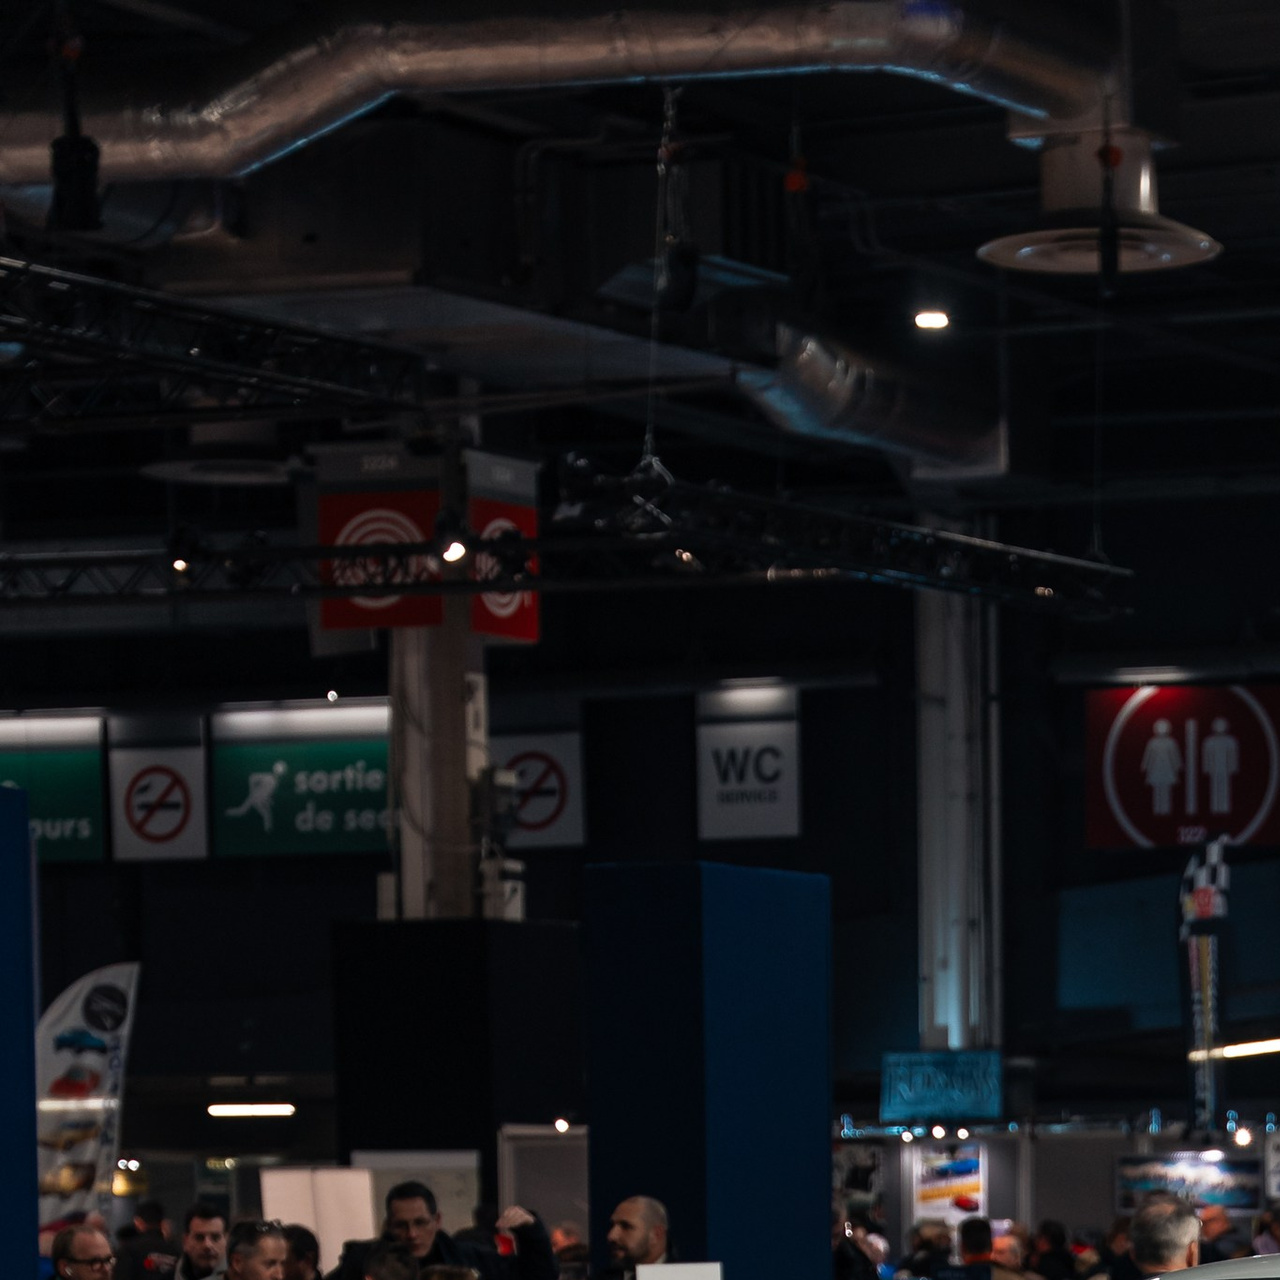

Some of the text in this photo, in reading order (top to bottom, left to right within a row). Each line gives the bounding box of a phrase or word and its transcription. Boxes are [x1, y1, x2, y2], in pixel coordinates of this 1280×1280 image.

[294, 760, 386, 794] sortie
[711, 746, 782, 784] WC
[295, 800, 335, 833] de
